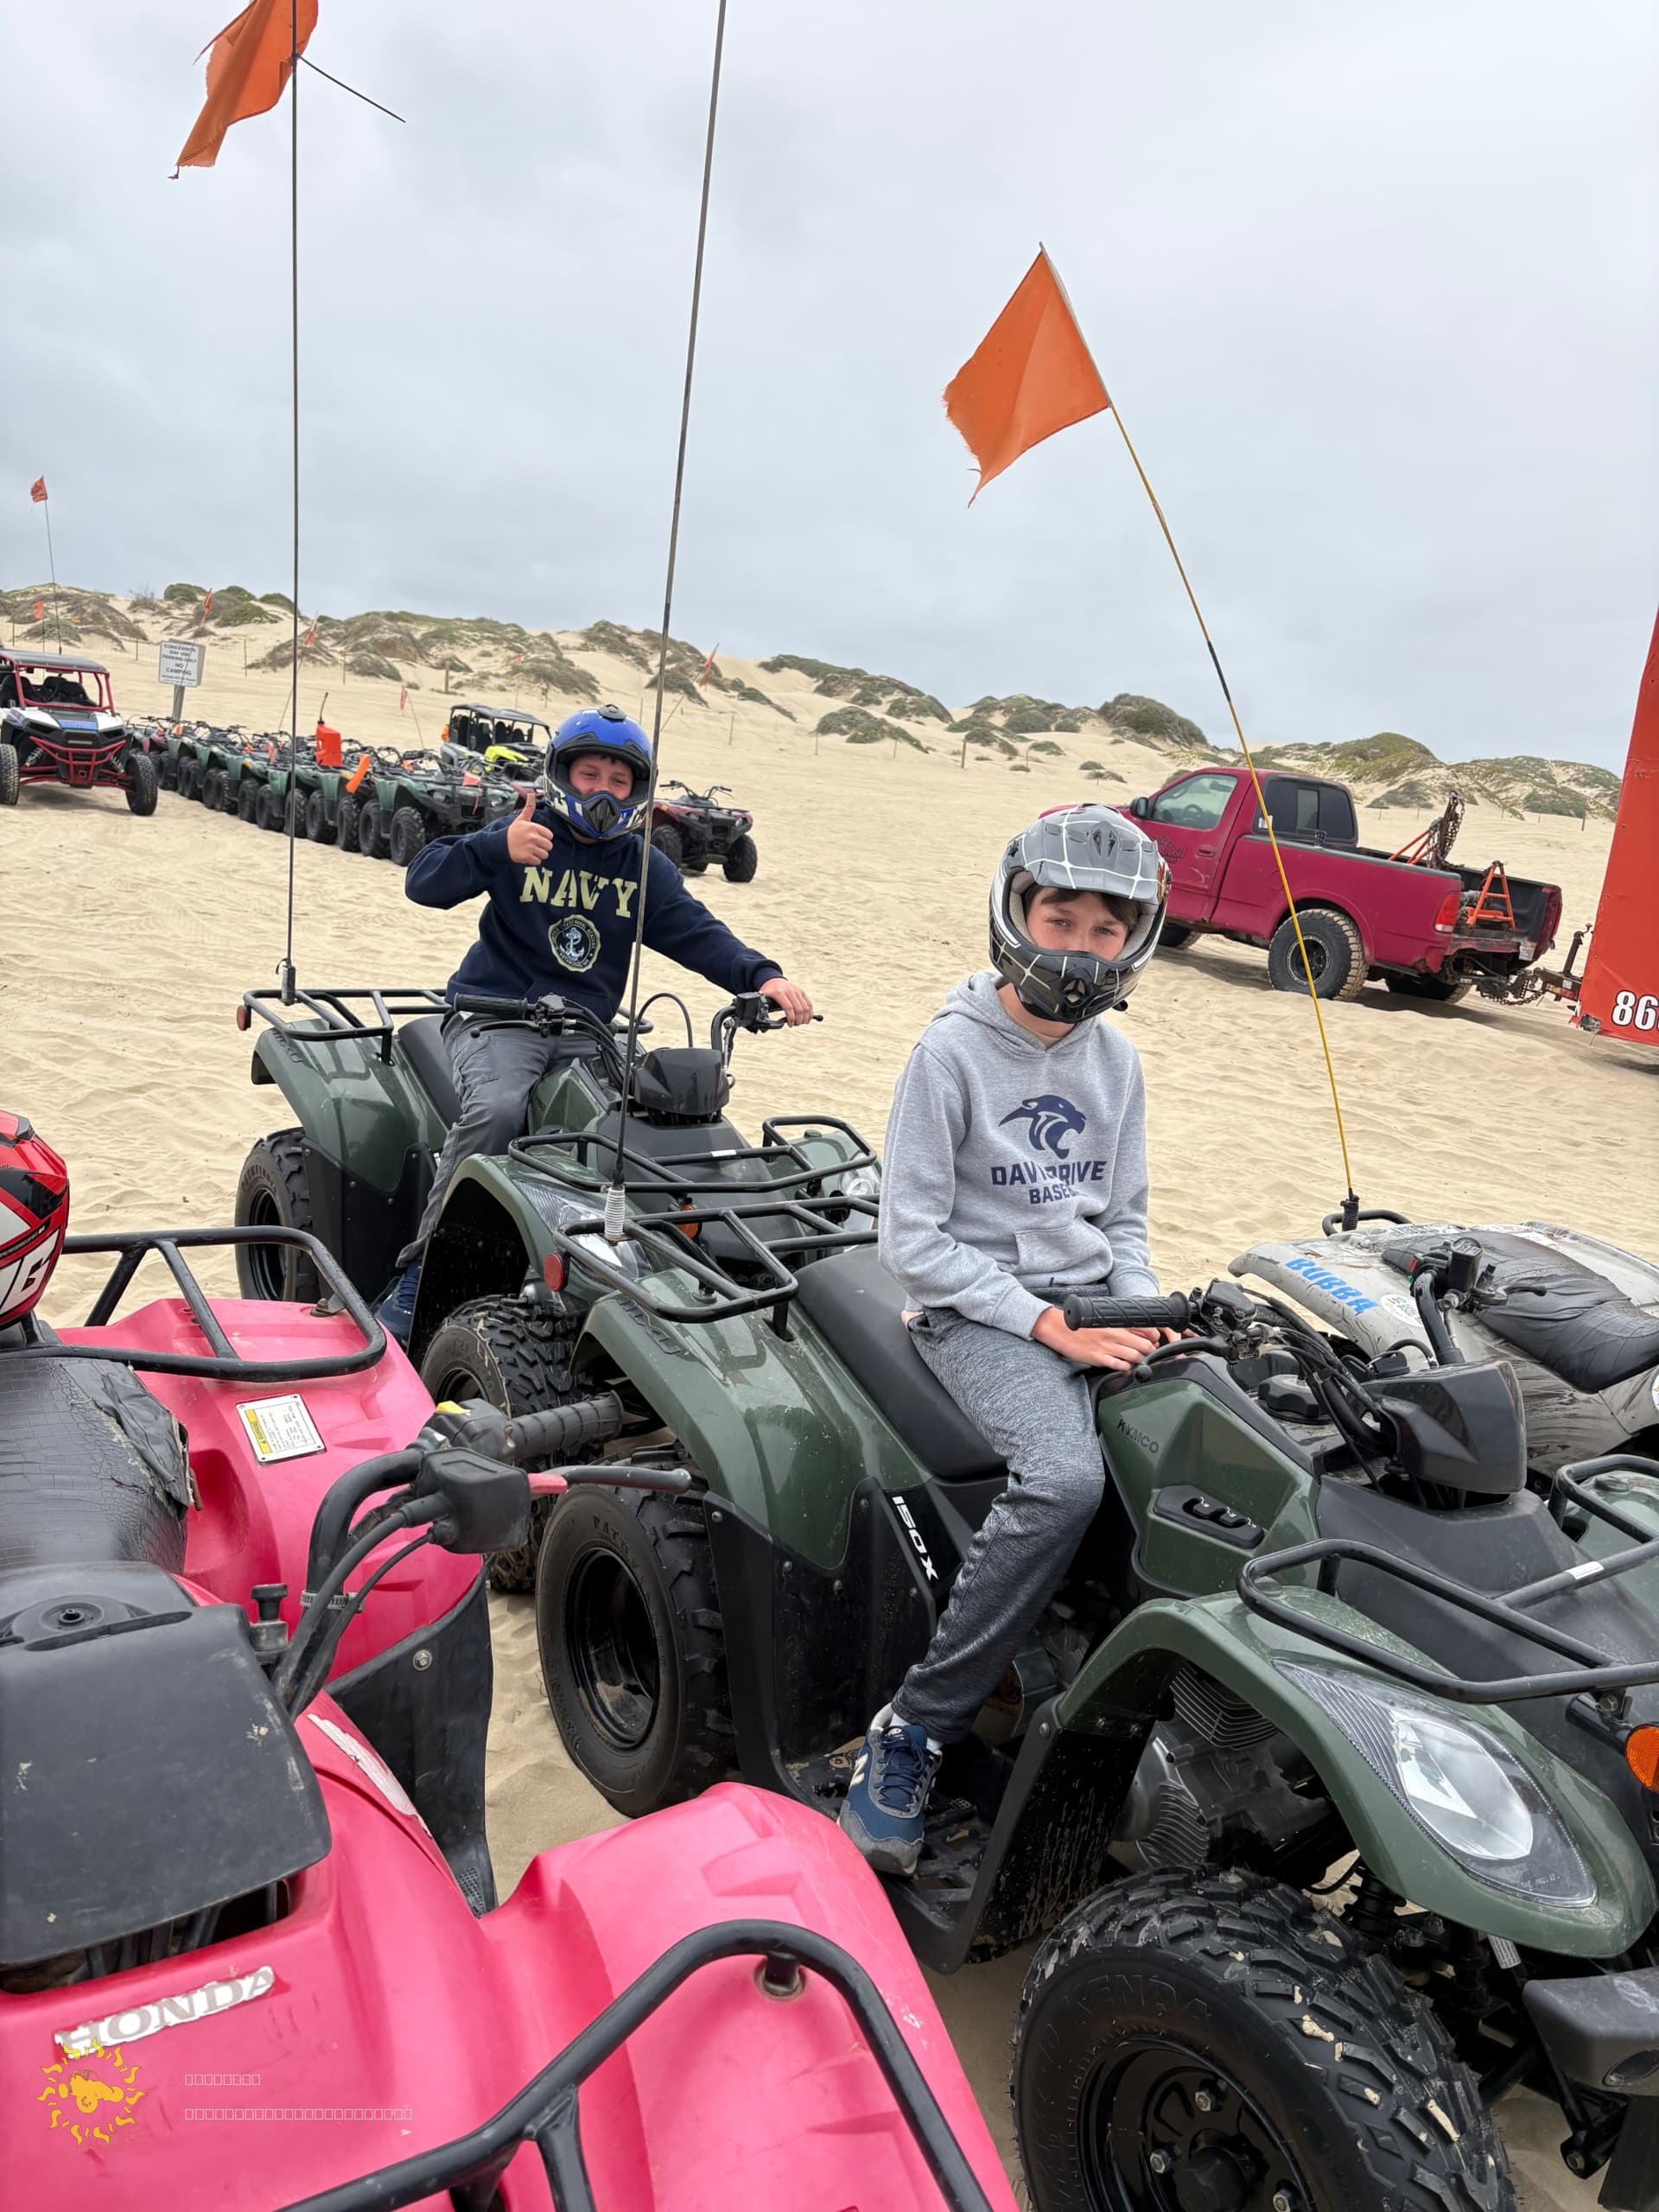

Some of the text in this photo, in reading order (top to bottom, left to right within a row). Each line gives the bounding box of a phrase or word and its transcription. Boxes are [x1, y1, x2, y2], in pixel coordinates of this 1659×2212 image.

[166, 667, 192, 676] CAMPING
[519, 866, 638, 918] NAVY
[1611, 989, 1659, 1032] 86
[1285, 1257, 1380, 1316] BUBBA
[1116, 1418, 1160, 1453] KYMCO
[55, 1968, 276, 2052] HONDA
